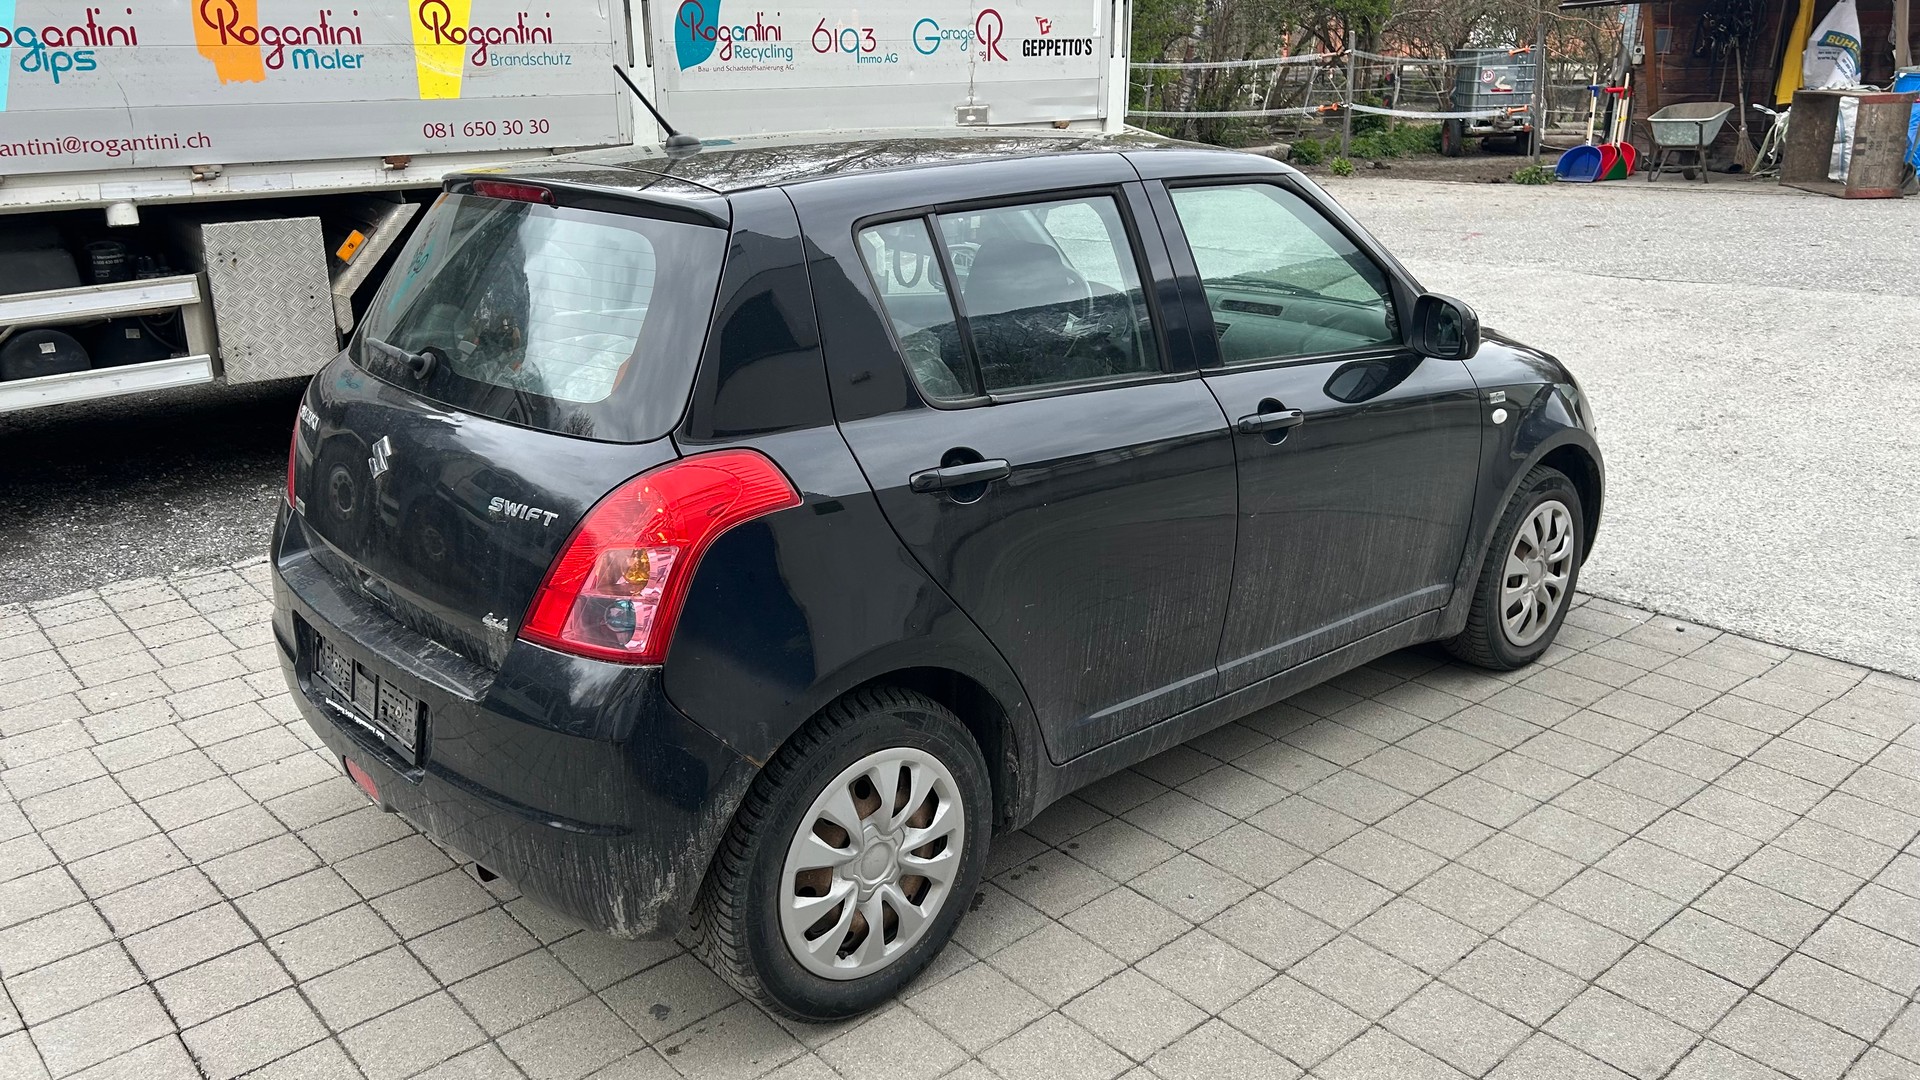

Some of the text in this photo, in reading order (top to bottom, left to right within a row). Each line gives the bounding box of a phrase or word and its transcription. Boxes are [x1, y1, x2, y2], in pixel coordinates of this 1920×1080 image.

[200, 0, 362, 69] Rogantini
[419, 0, 552, 66] Rogantini
[678, 0, 782, 61] Rogantini
[912, 18, 975, 54] Garage
[490, 52, 572, 67] Brandschutz
[734, 44, 793, 62] Recycling
[884, 52, 898, 63] AG
[1022, 38, 1093, 57] GEPPETTO'S
[423, 118, 550, 138] 081 650 30 30
[487, 496, 559, 527] SWIFT
